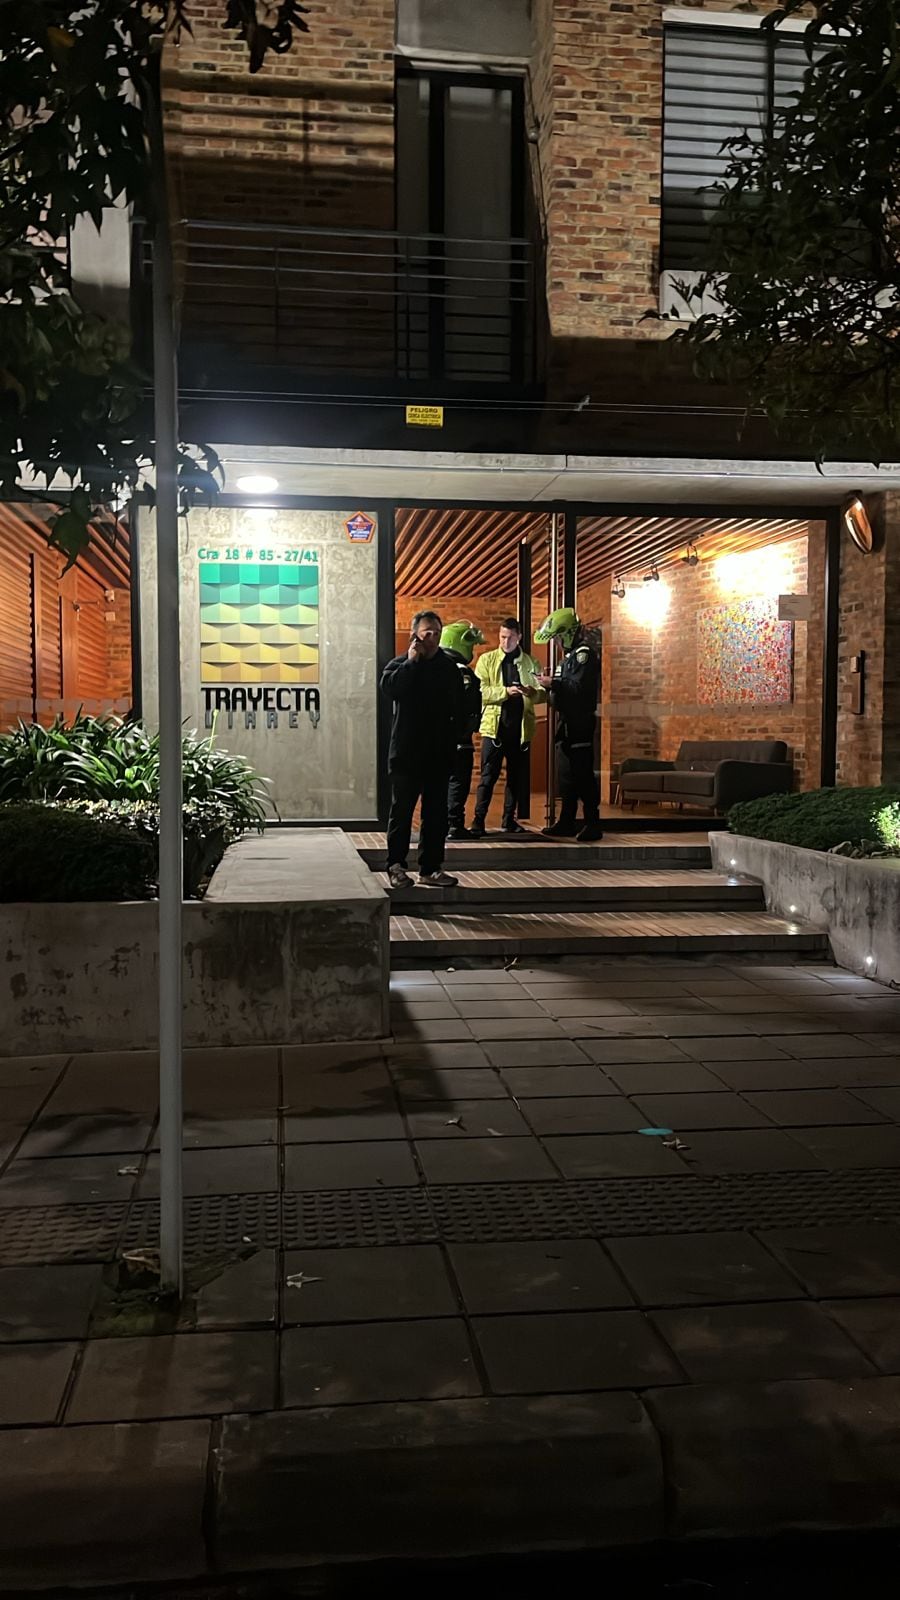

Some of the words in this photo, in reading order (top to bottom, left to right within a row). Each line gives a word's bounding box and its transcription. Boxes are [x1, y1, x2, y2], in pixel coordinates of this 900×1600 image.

[197, 548, 219, 560] Cra
[225, 549, 239, 560] 18
[246, 549, 253, 560] #
[259, 549, 273, 561] 85
[200, 687, 320, 711] TRAYECTA
